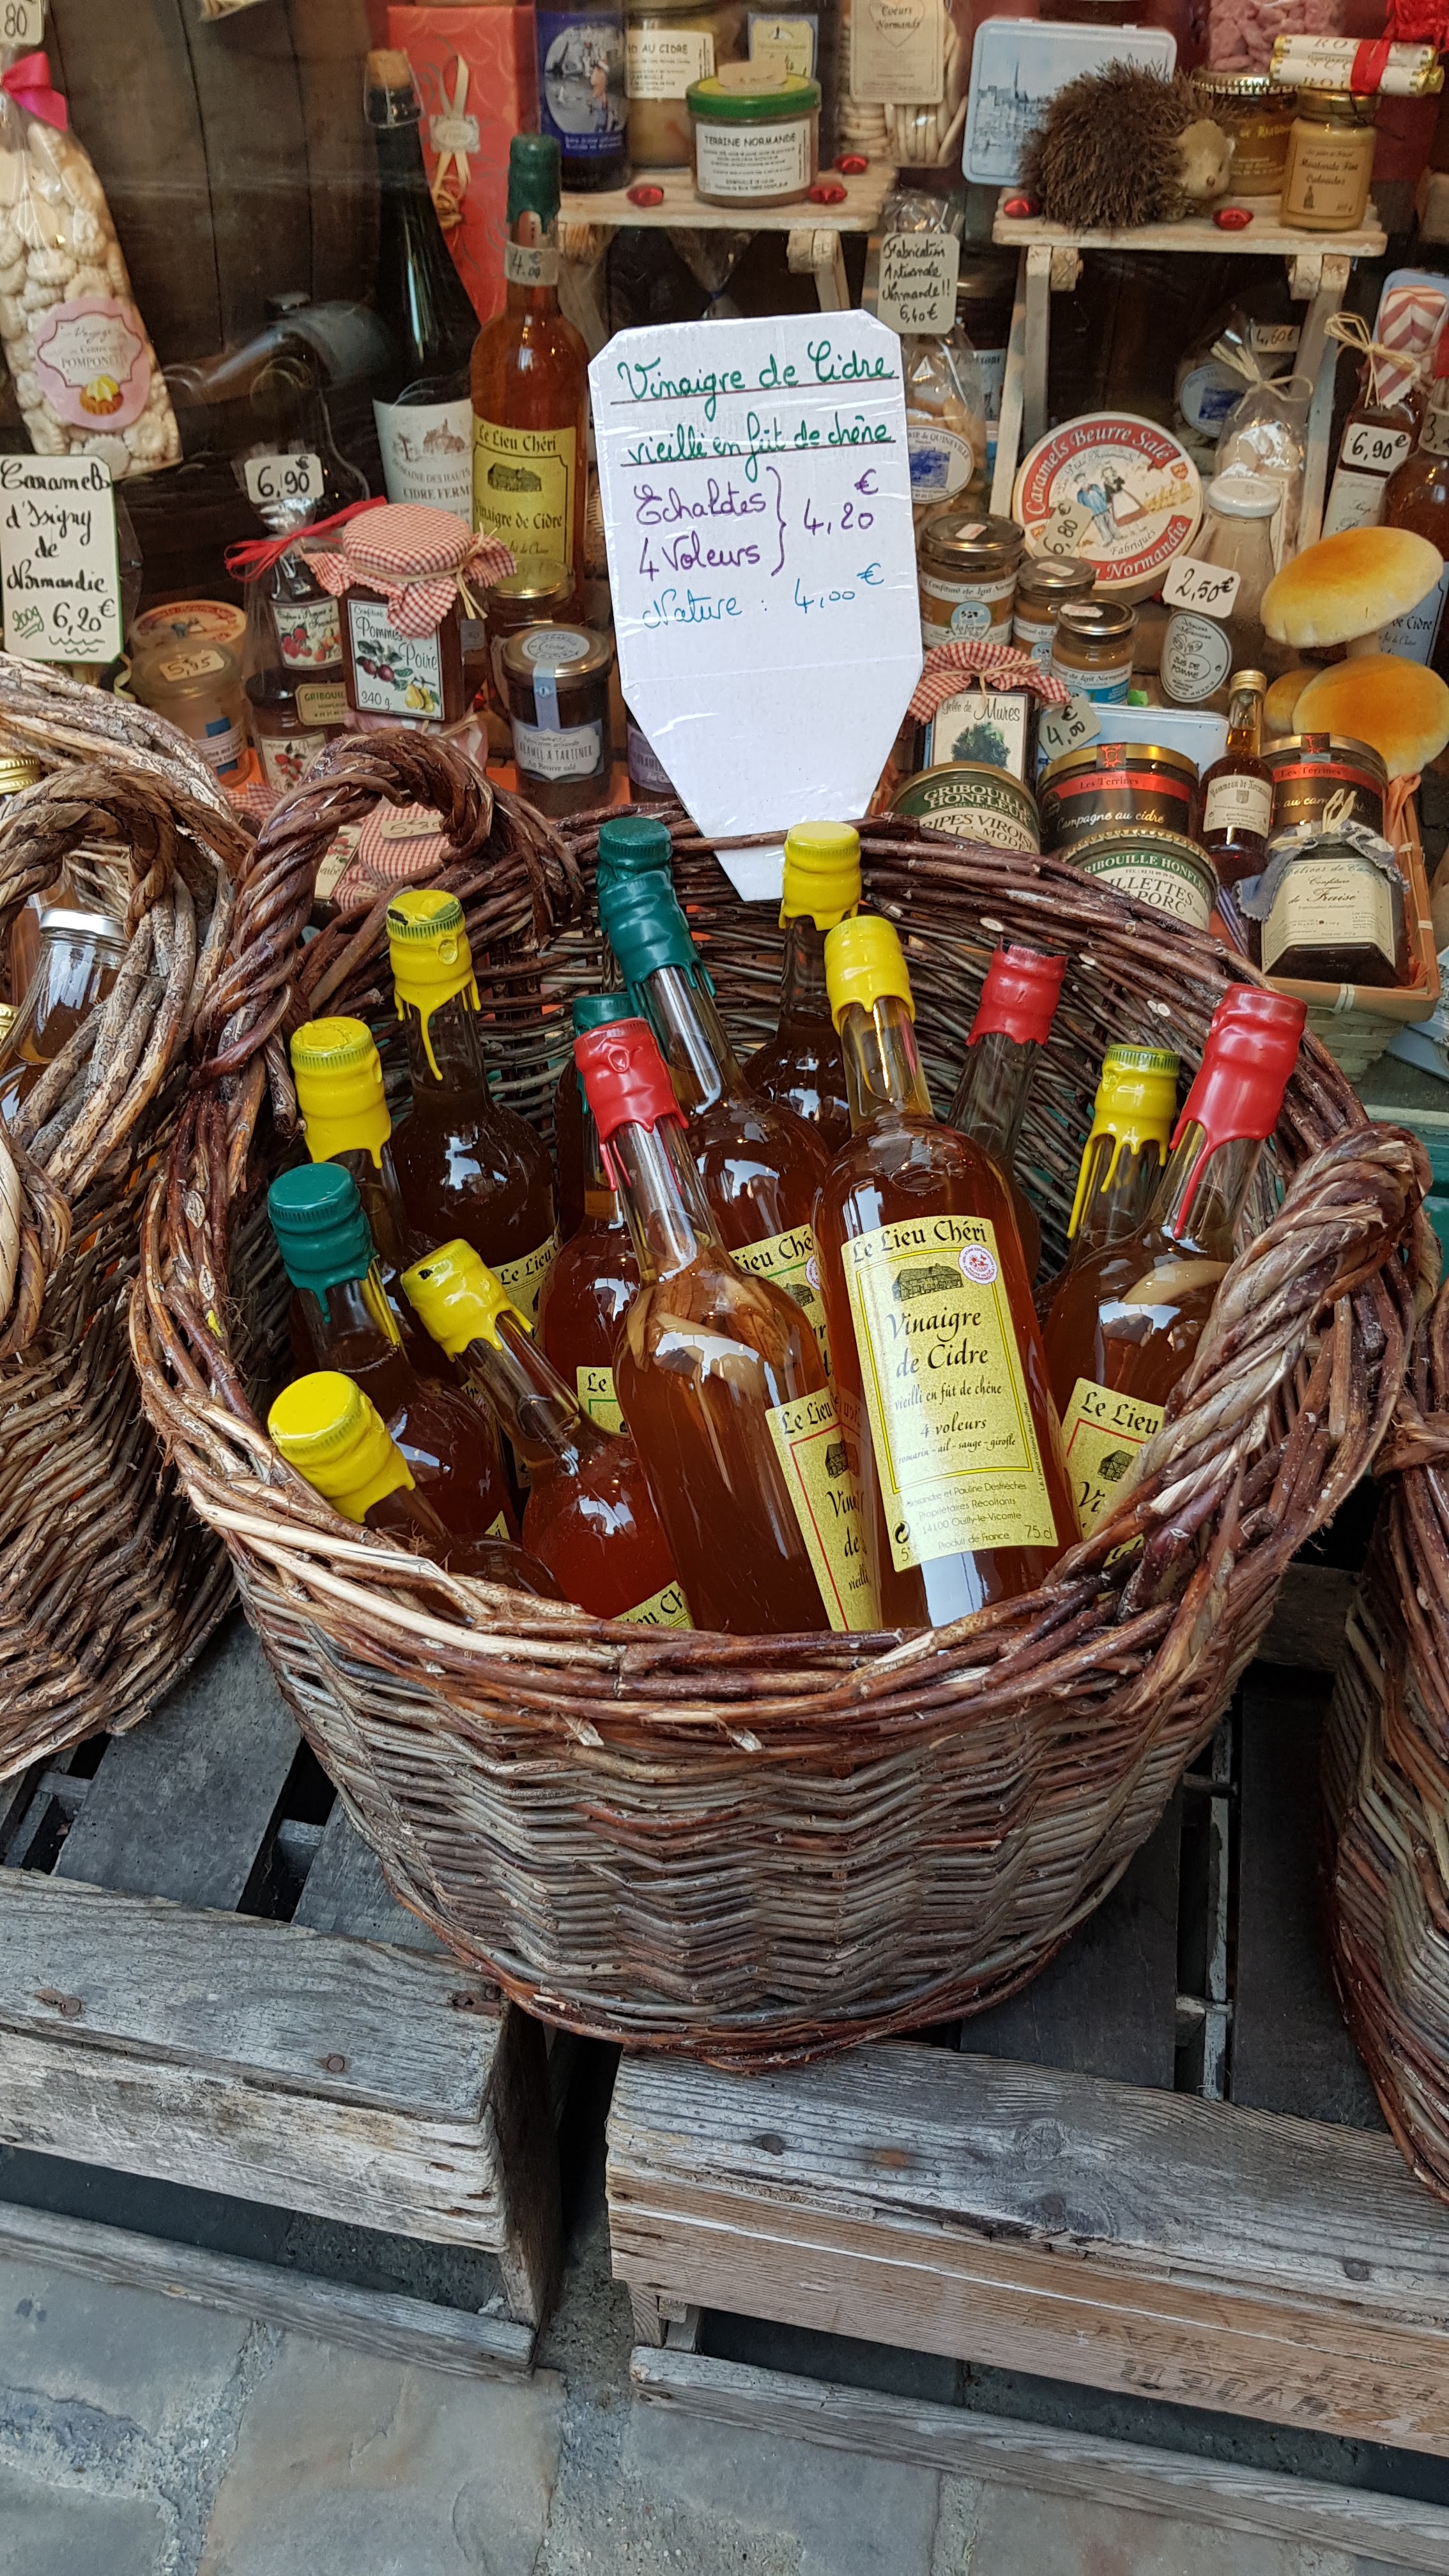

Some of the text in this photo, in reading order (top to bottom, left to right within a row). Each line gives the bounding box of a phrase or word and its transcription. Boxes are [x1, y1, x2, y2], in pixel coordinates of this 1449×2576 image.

[659, 43, 689, 54] CIDRE
[704, 132, 796, 147] TERRINE NORMANDE
[617, 341, 895, 422] Vinaigre de Cidre
[479, 424, 557, 452] Le Lieu Chéri
[713, 440, 741, 456] en
[793, 419, 821, 449] de
[828, 411, 893, 445] chêne
[1025, 425, 1174, 516] Caramels Beurre Salé
[402, 485, 470, 500] CIDRE FERM
[516, 512, 563, 530] de Cidre
[34, 535, 60, 558] de
[638, 530, 762, 582] 4 Voleurs
[1106, 521, 1188, 581] Normandie
[6, 558, 109, 593] Normandie
[642, 588, 743, 629] Nature
[355, 617, 402, 641] Pommes
[398, 641, 438, 671] Poire
[1171, 664, 1199, 679] POMME
[361, 691, 382, 705] 340
[962, 700, 972, 712] de
[973, 698, 1021, 722] Mures
[1080, 775, 1139, 790] Les Terrines
[1280, 766, 1342, 778] Les Terrines
[928, 793, 1030, 827] HONFLEUR
[1282, 799, 1301, 808] au
[1057, 809, 1165, 831] Campagne au cidre
[1084, 855, 1158, 874] RIBOUILLE
[1307, 886, 1356, 902] Fraise
[733, 1230, 814, 1271] ieu Ché
[853, 1220, 987, 1264] Le Lieu Chéri
[500, 1248, 553, 1285] Le Lieu
[884, 1307, 982, 1342] Vinaigre
[896, 1337, 988, 1377] de Cidre
[586, 1372, 608, 1393] Le
[894, 1374, 1002, 1411] vieilli en fût de chêne
[781, 1411, 804, 1436] Le
[920, 1411, 988, 1438] 4 voleurs
[1080, 1391, 1160, 1435] Le Lieu
[898, 1433, 1016, 1465] romarin ail sauge girofle
[944, 1490, 953, 1499] et
[954, 1484, 983, 1496] Pauline
[918, 1497, 1016, 1521] Propriétaires Récoltants
[922, 1519, 950, 1535] 14100
[1024, 1524, 1053, 1540] 75 cl
[844, 1526, 861, 1558] de
[937, 1531, 1011, 1551] Produit de France
